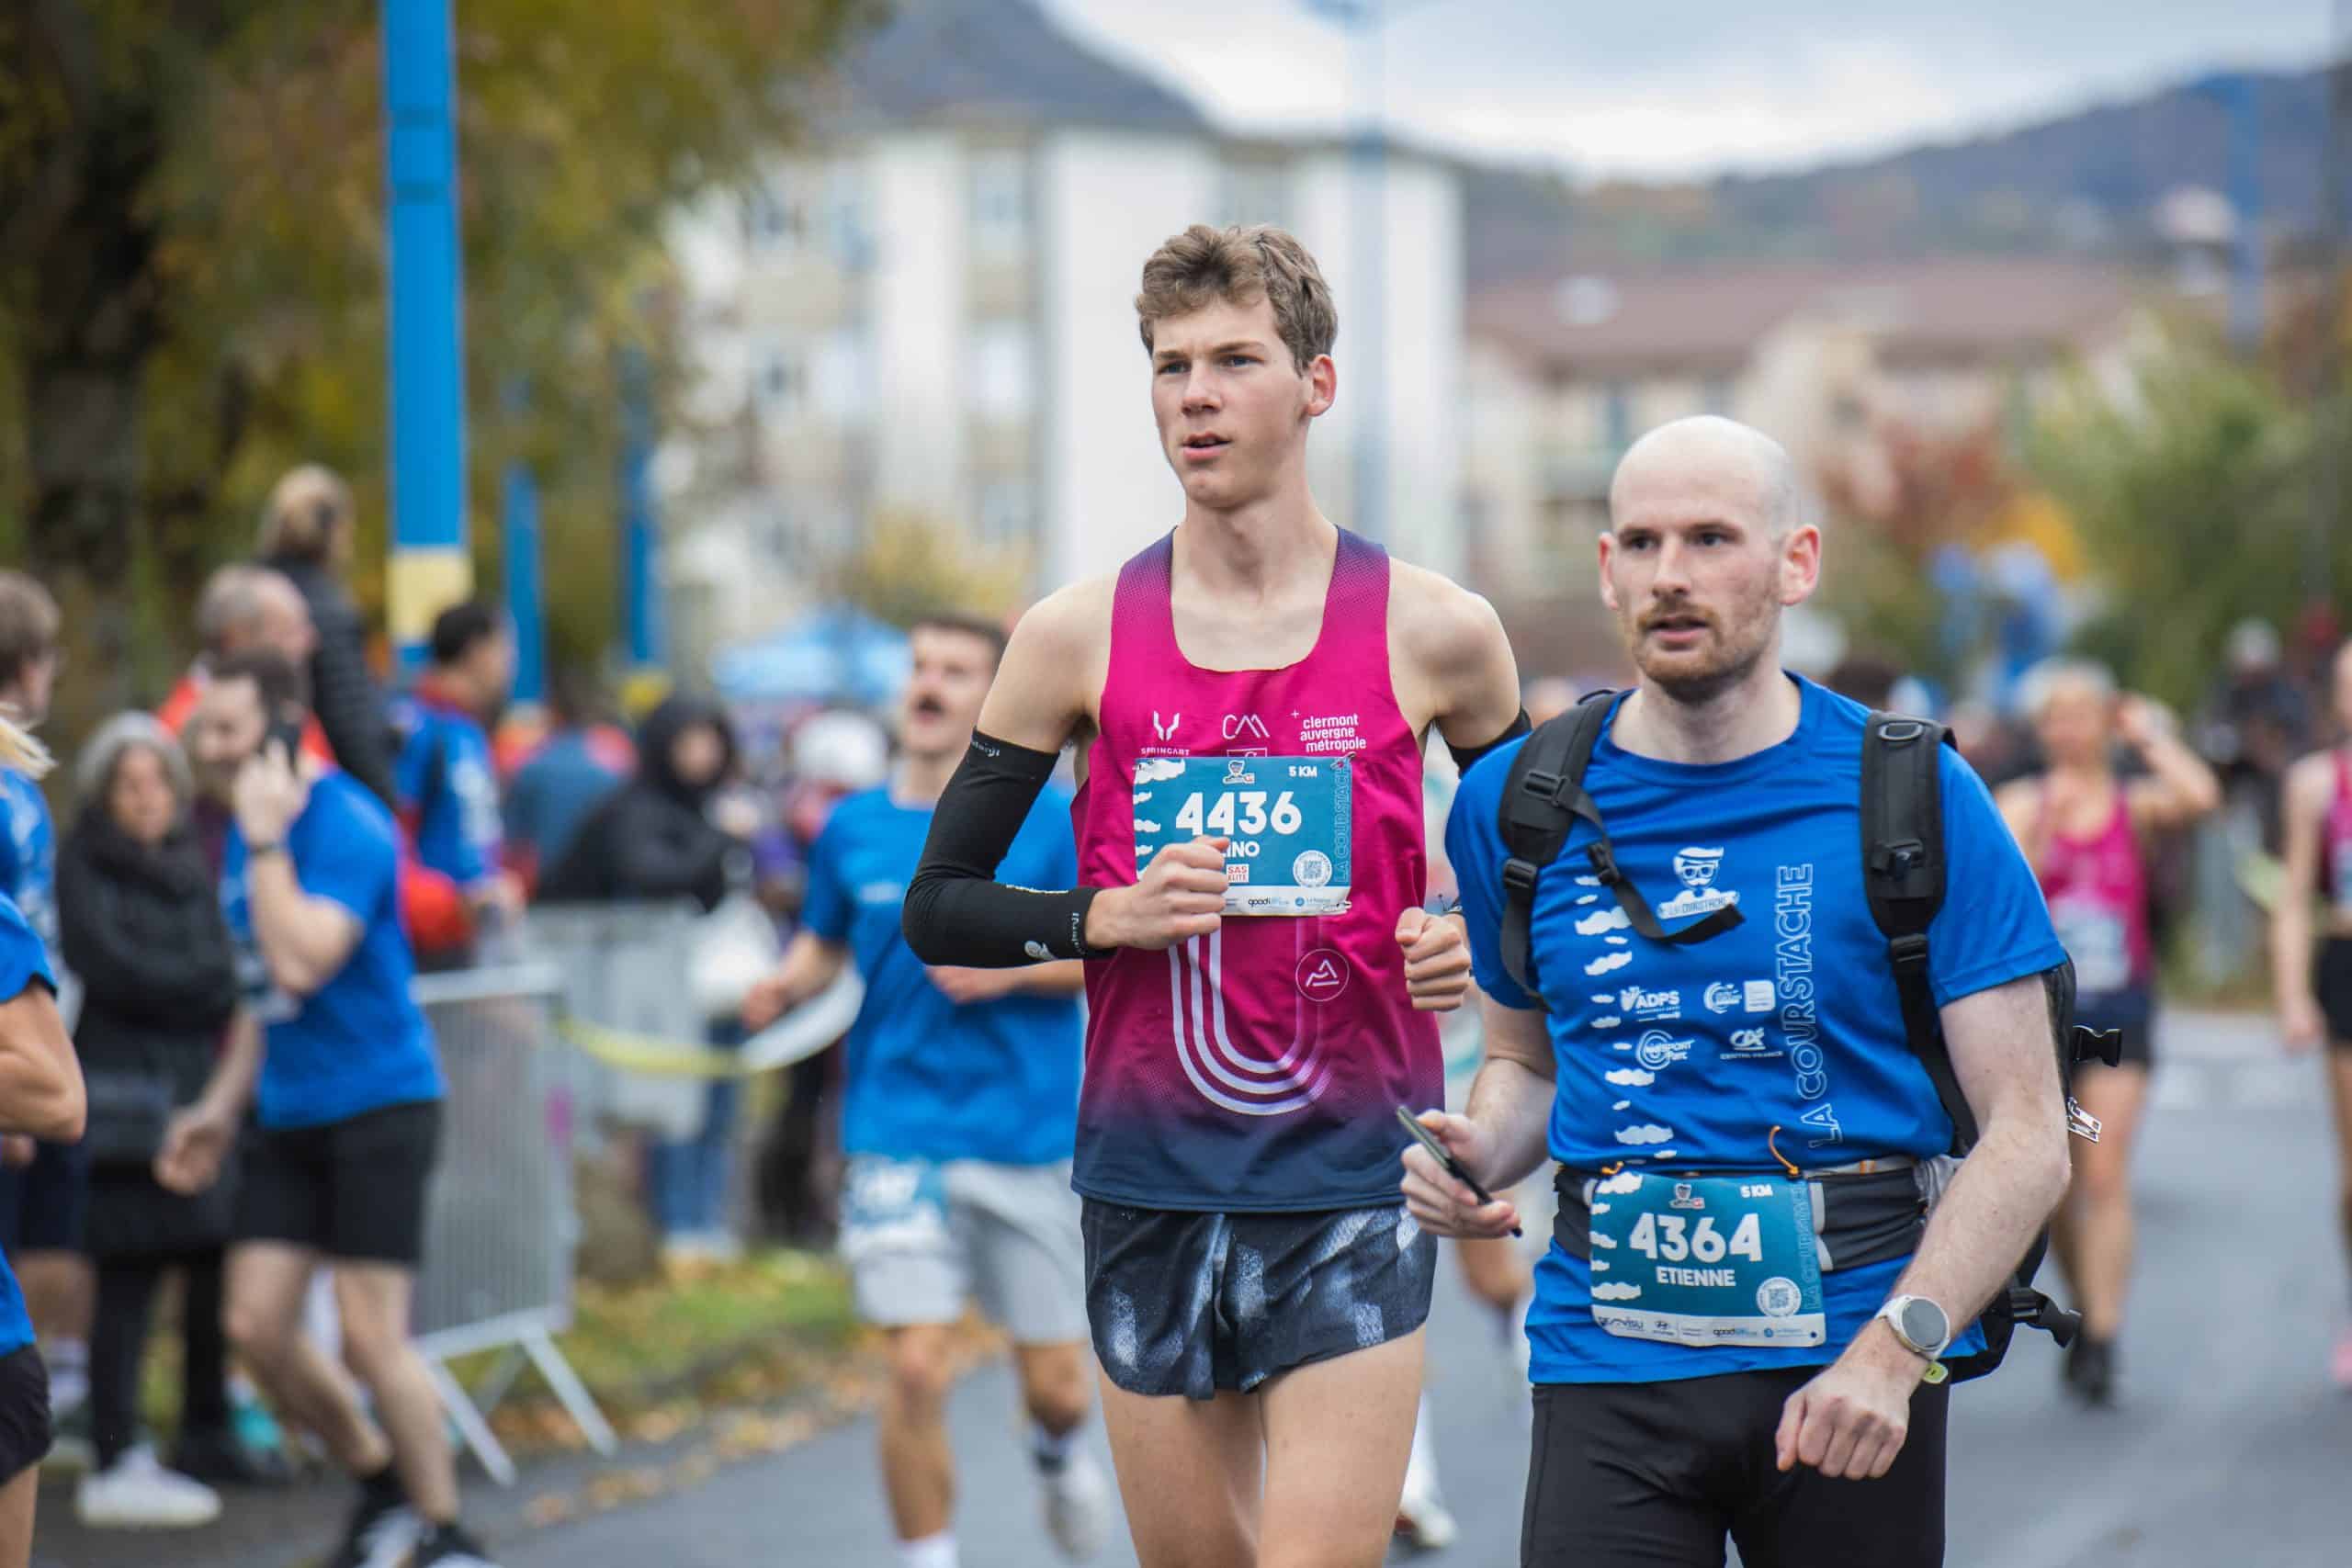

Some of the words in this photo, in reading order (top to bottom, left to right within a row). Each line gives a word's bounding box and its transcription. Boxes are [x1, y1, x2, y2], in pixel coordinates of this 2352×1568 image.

[1303, 714, 1358, 729] clermont
[1300, 727, 1355, 740] auvergne
[1306, 738, 1366, 753] métropole
[1288, 765, 1296, 777] 5
[1298, 765, 1317, 777] KM
[1175, 791, 1303, 836] 4436
[1221, 840, 1261, 858] INO
[1227, 865, 1248, 874] SAS
[1776, 863, 1827, 1100] COURSTACHE
[1635, 990, 1680, 1009] ADPS
[1801, 1103, 1843, 1149] LA
[1740, 1186, 1751, 1198] 5
[1629, 1213, 1763, 1263] 4364
[1656, 1267, 1736, 1287] ETIENNE
